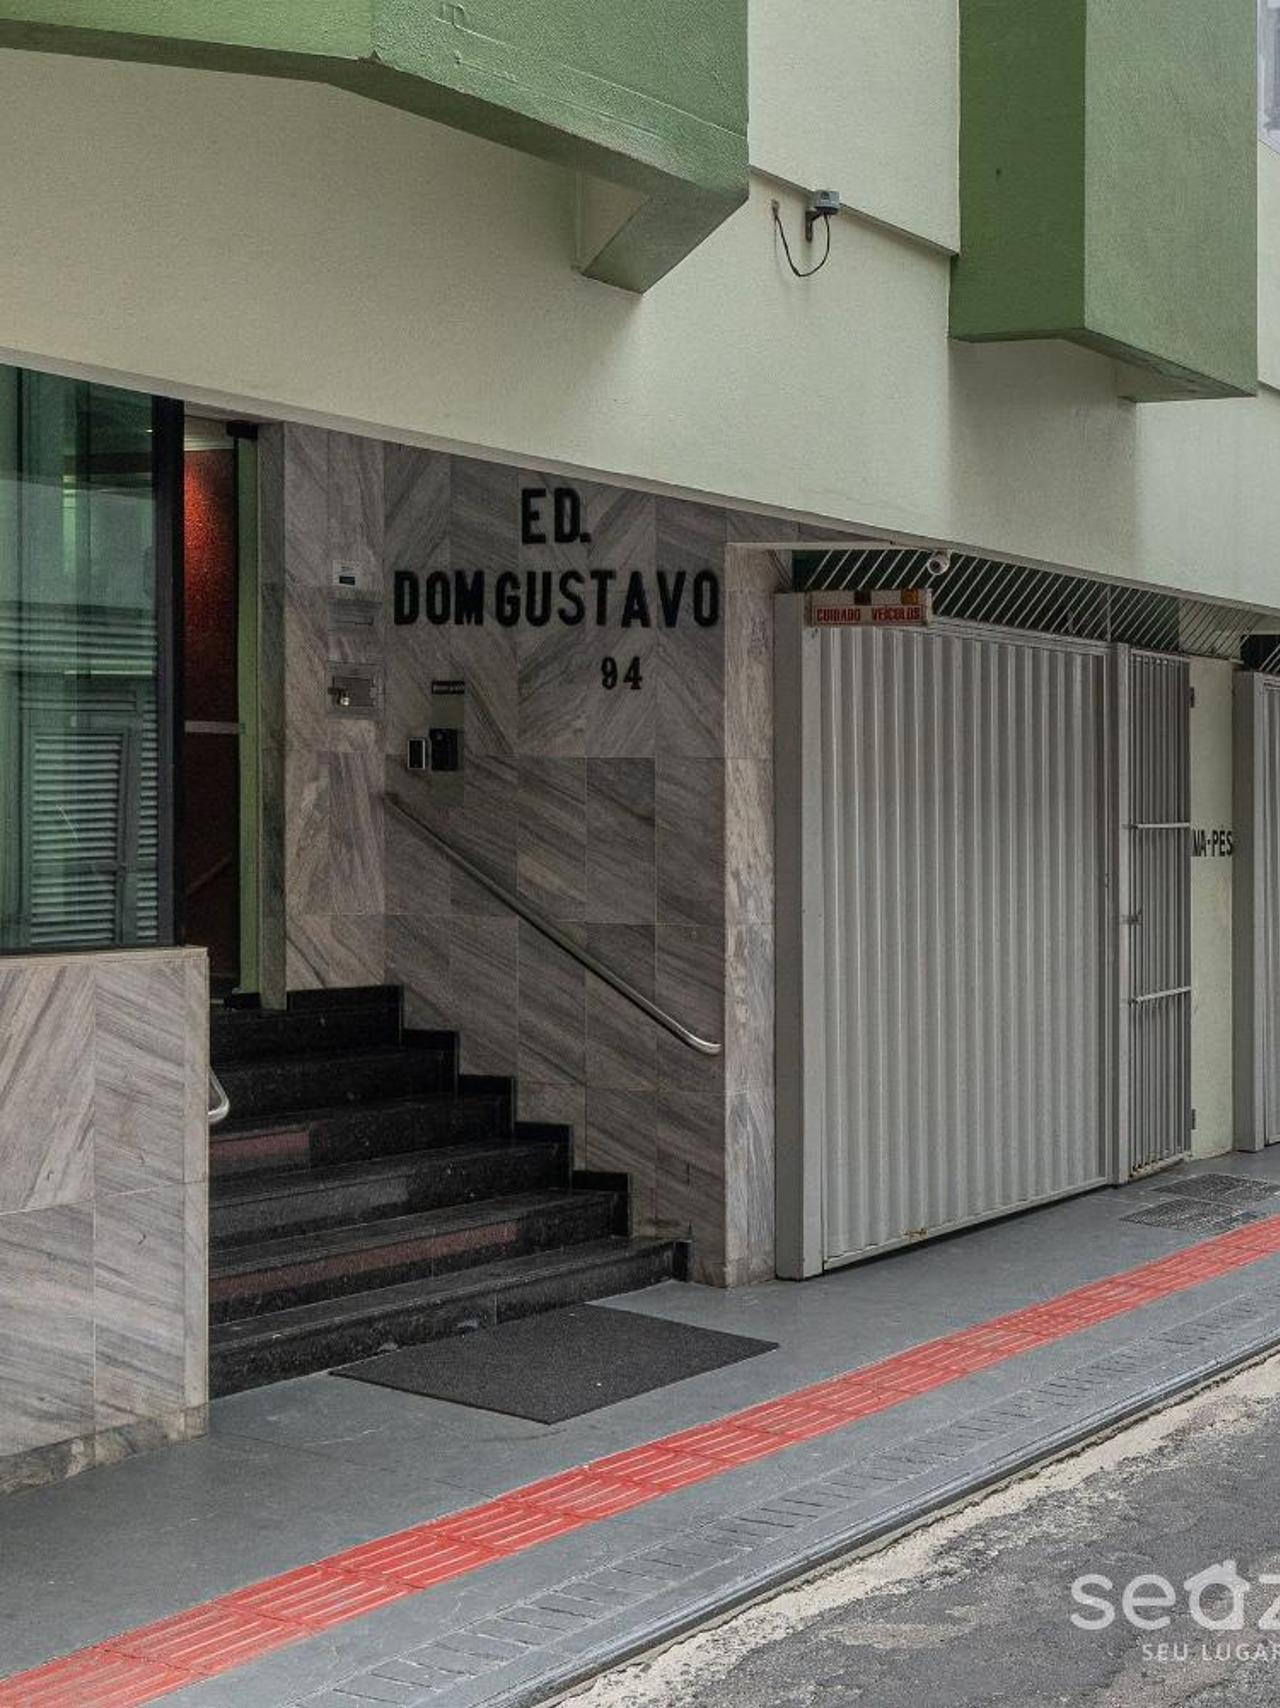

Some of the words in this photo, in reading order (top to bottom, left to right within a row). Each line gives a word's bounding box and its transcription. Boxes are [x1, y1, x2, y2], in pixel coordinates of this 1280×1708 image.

[521, 488, 591, 544] ED.
[816, 608, 861, 622] CUIDADO
[601, 656, 643, 690] 94
